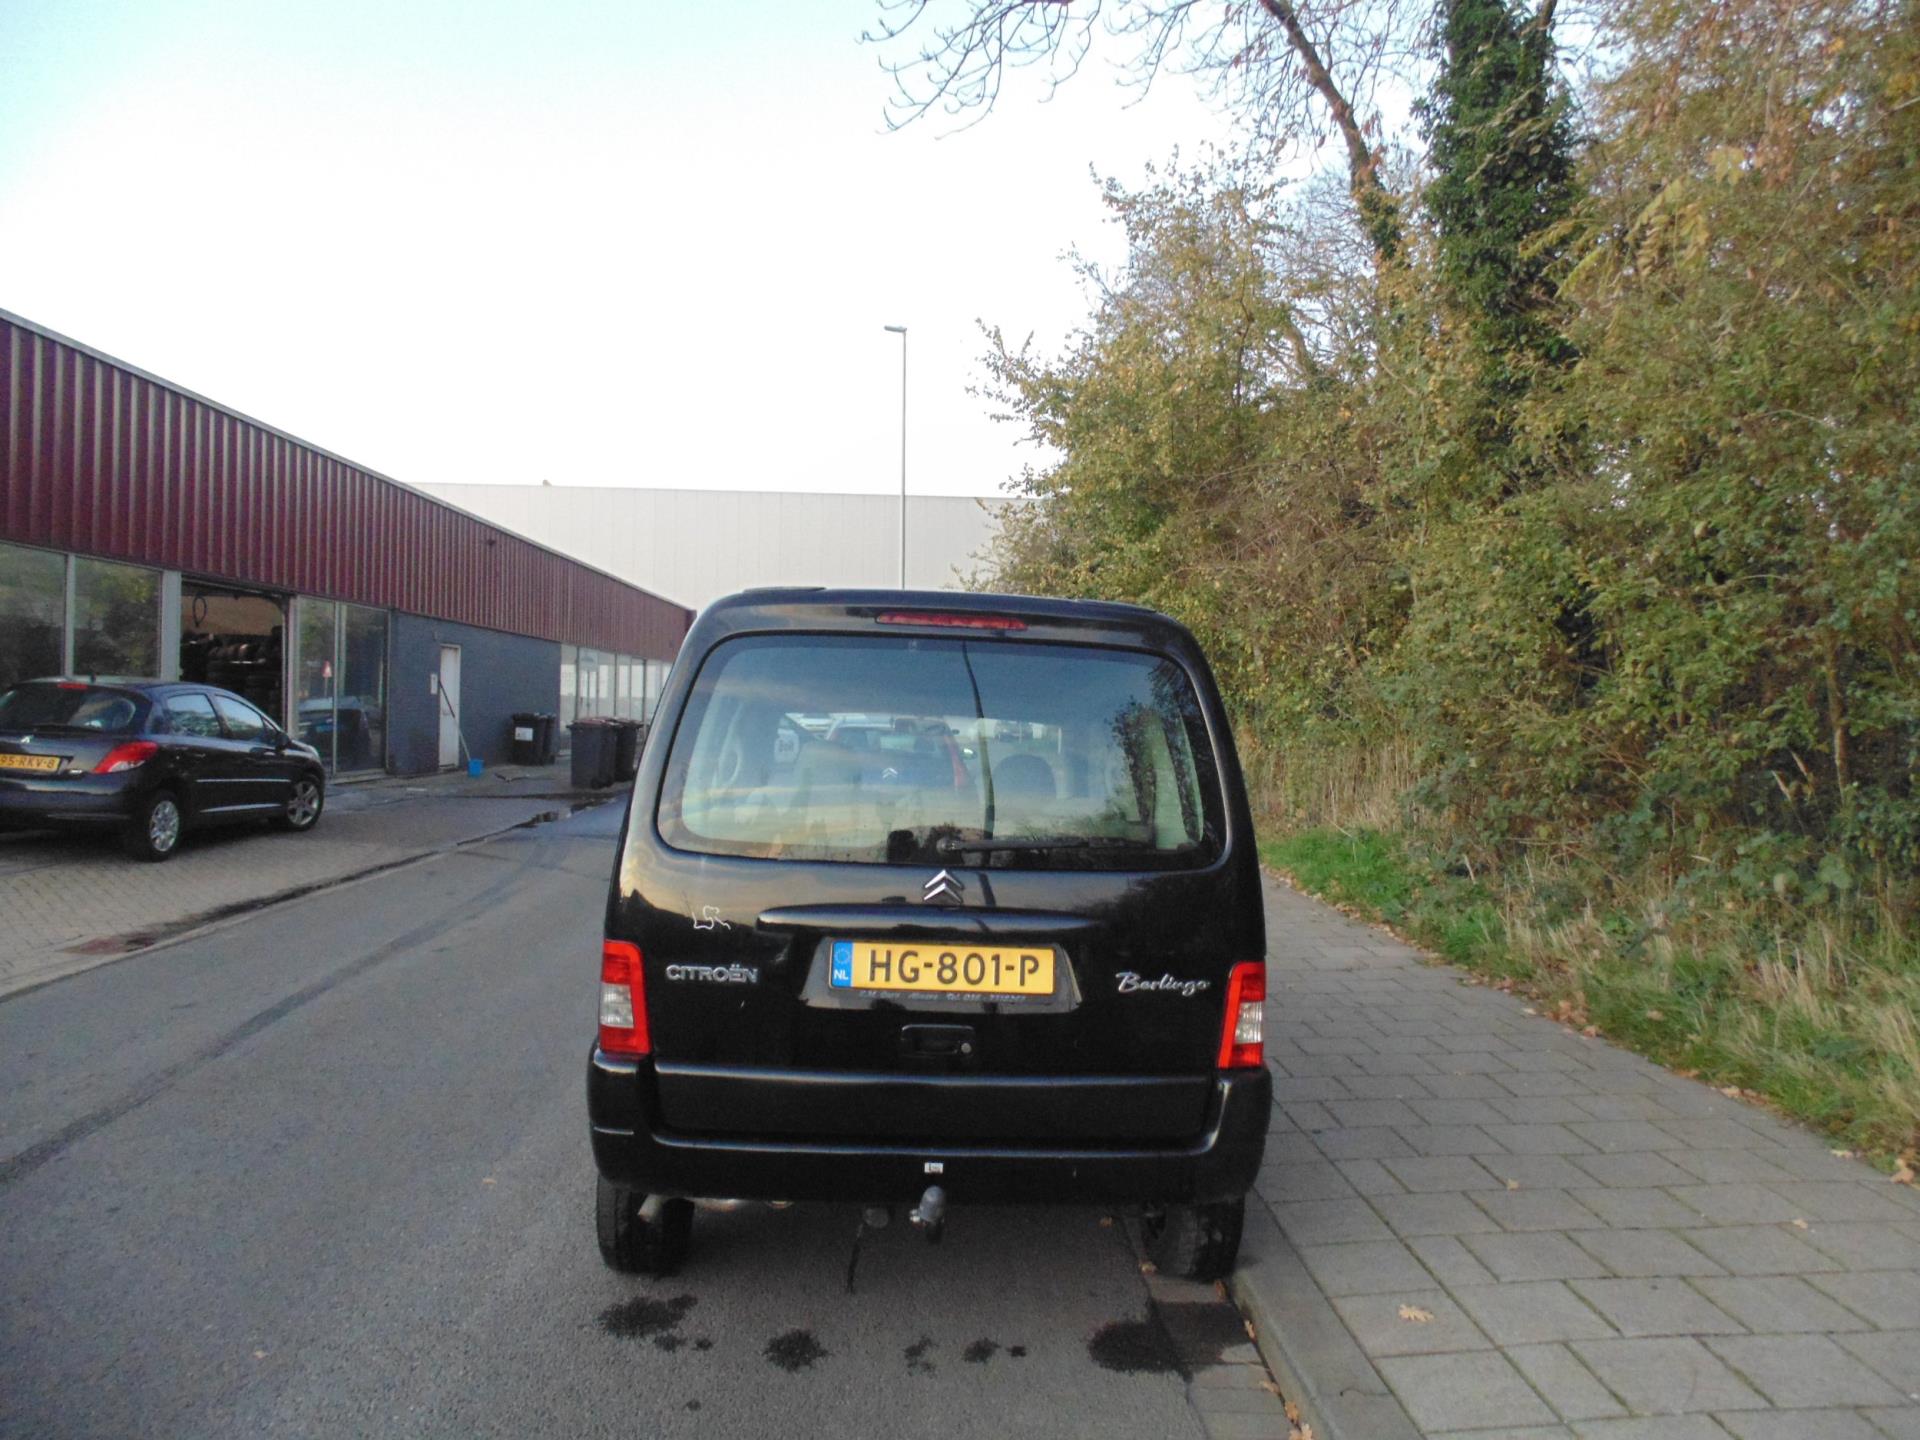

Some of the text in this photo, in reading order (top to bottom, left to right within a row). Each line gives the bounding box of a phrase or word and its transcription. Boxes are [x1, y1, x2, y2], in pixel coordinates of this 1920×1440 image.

[666, 963, 759, 983] CITROËN
[834, 968, 849, 980] NL
[868, 948, 1040, 987] HG-801-P
[1115, 971, 1211, 997] Berlingo
